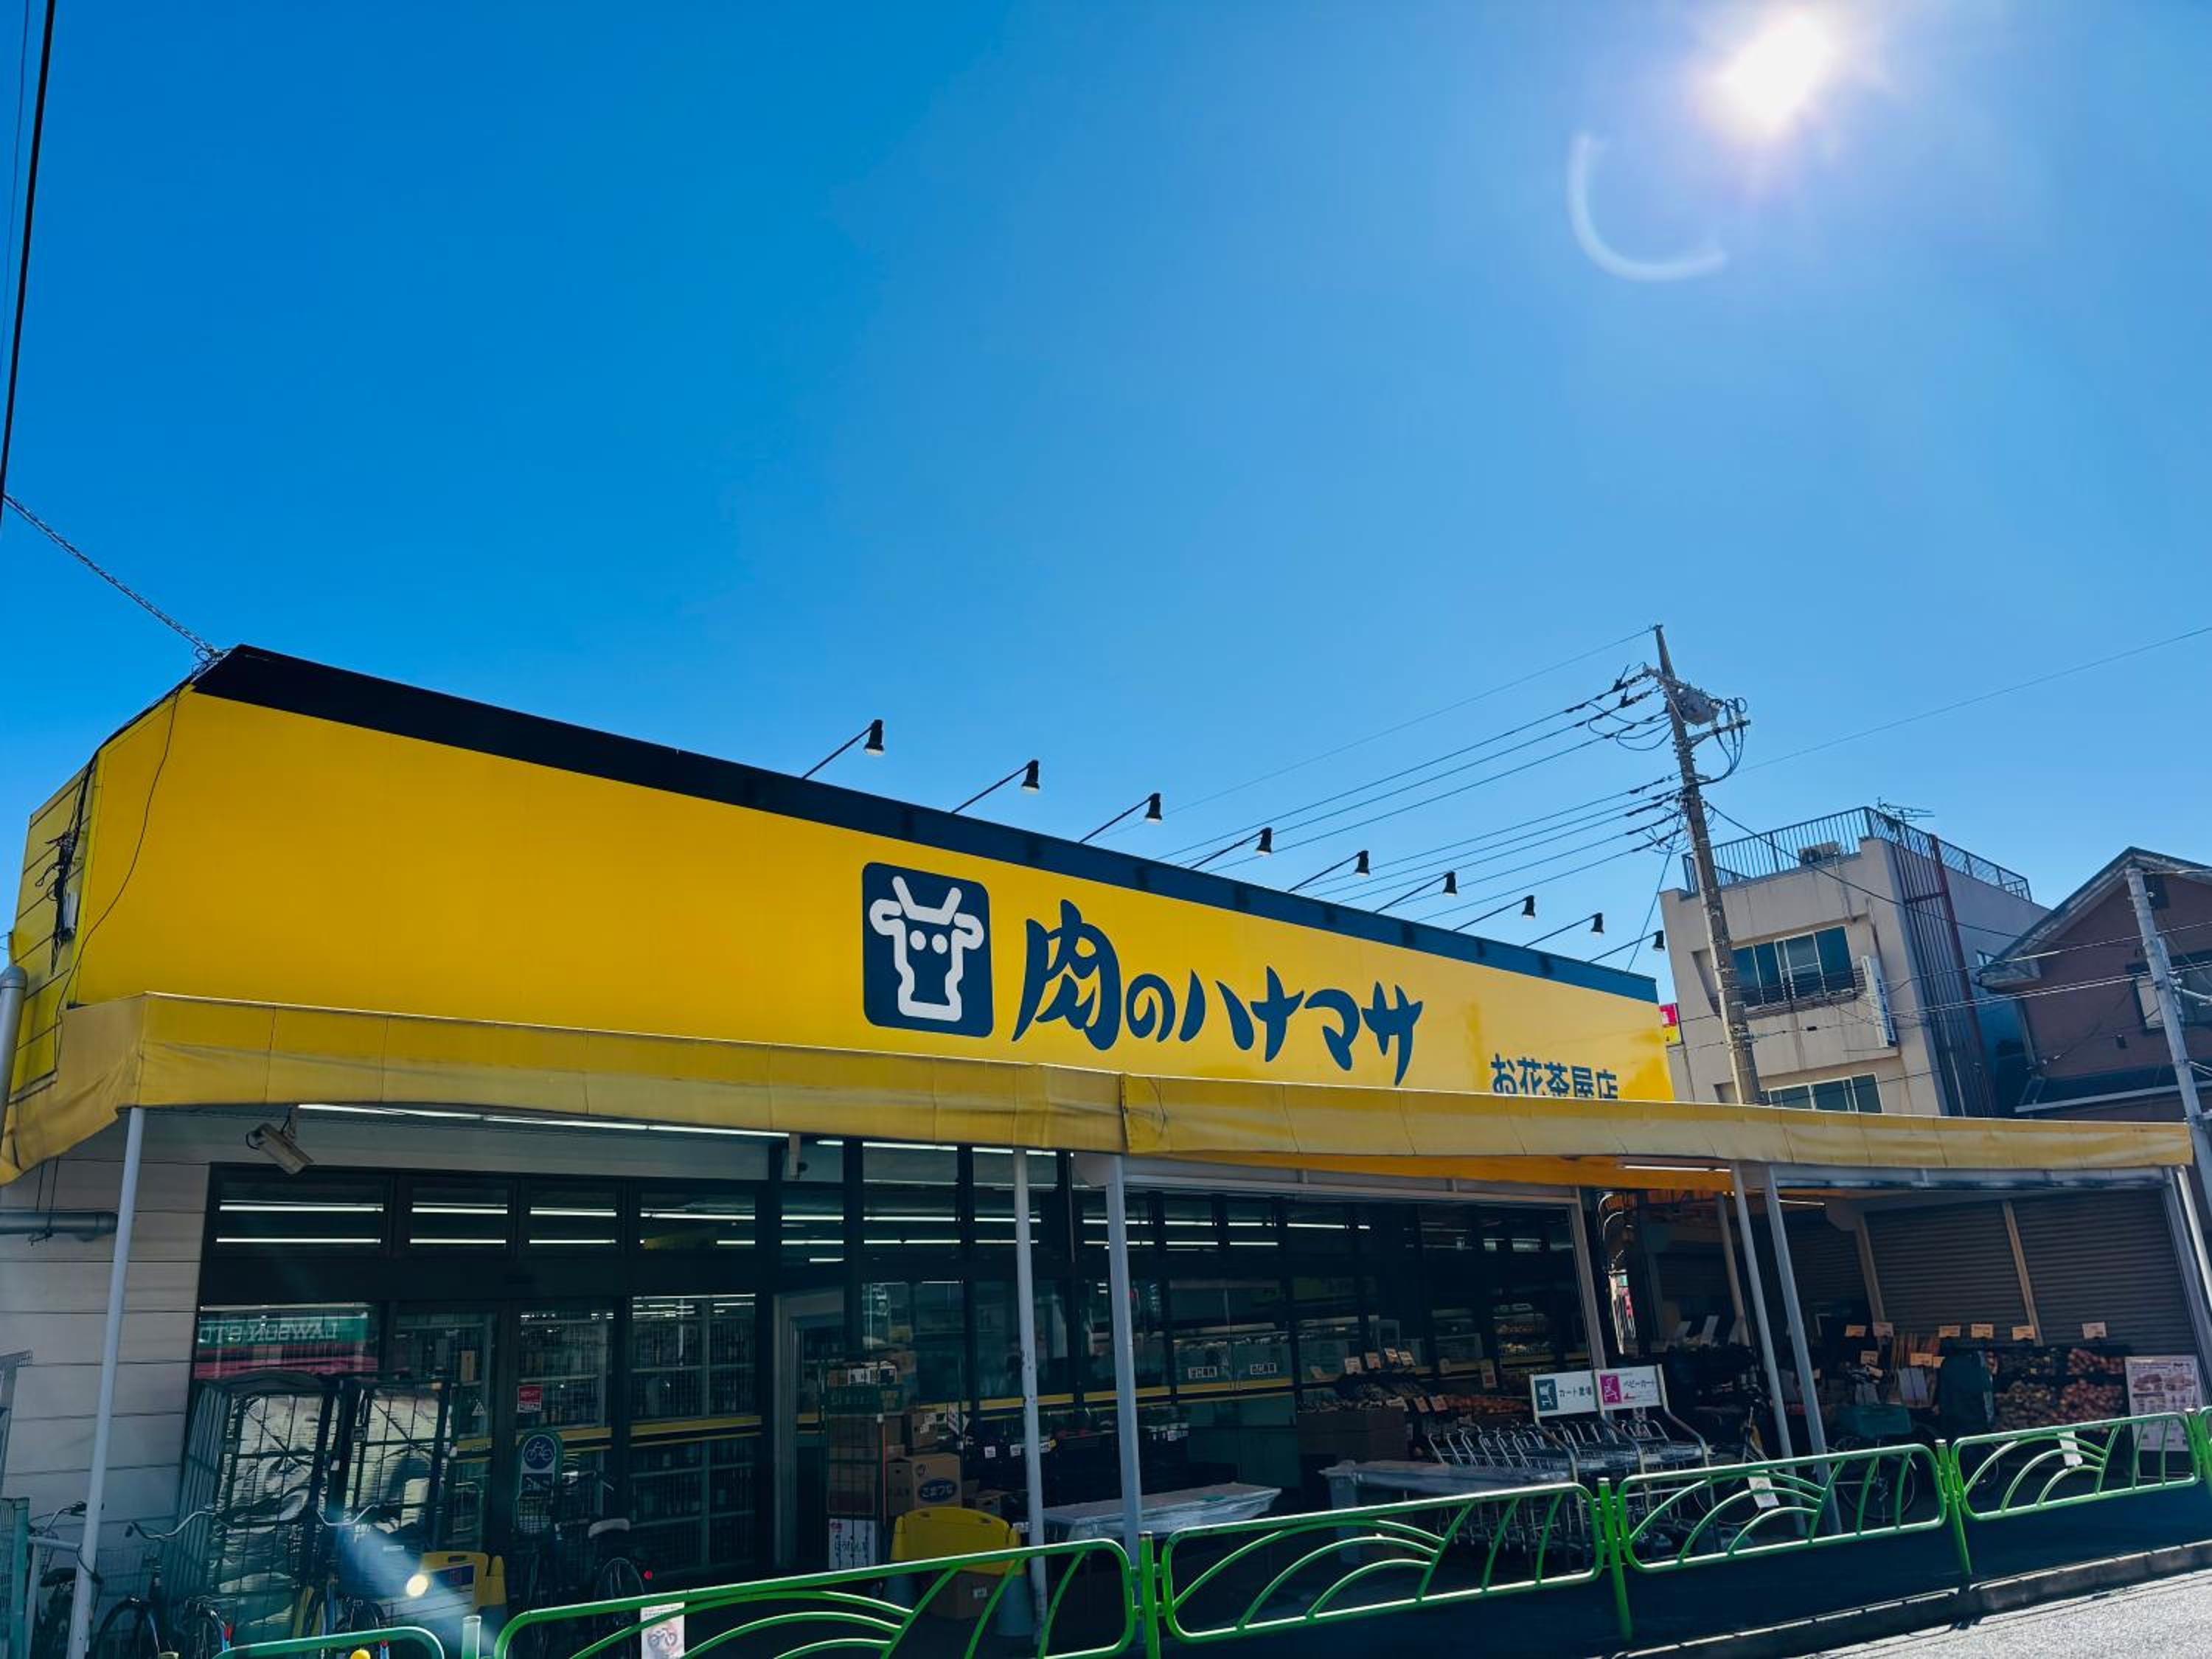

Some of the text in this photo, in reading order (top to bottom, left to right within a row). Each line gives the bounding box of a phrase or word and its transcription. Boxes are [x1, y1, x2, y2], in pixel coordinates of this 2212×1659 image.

[1012, 899, 1423, 1085] 肉のハナマサ
[1490, 1053, 1618, 1099] お花茶屋店
